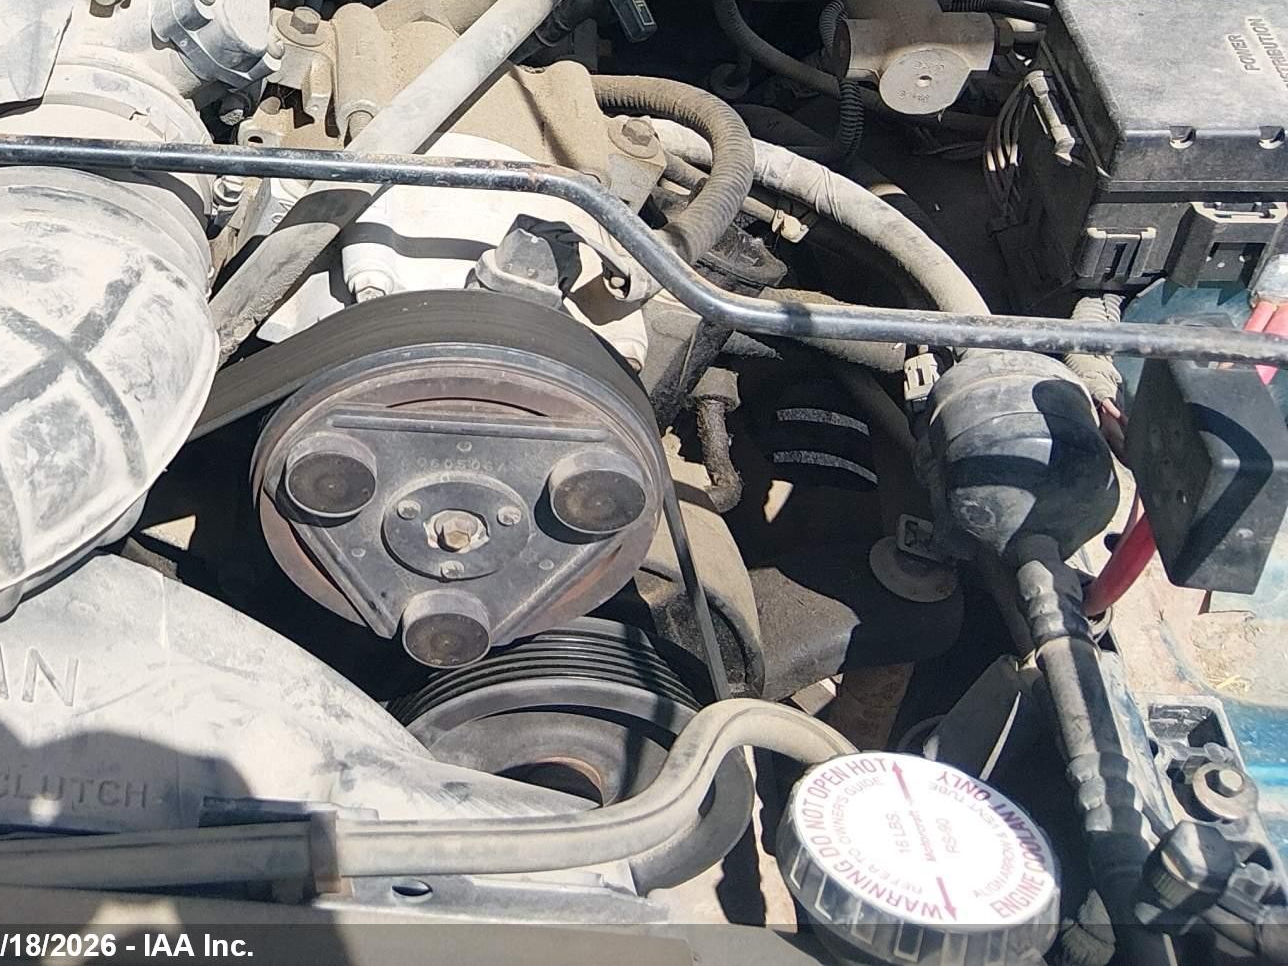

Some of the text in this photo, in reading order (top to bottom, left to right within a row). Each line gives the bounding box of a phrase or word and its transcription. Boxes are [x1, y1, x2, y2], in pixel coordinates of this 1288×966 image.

[1228, 34, 1261, 70] POWER
[844, 776, 882, 797] GUIDE
[937, 771, 991, 802] ONLY
[802, 757, 943, 920] WARNING DO NOT OPEN HOT
[990, 872, 1045, 918] ENGINE
